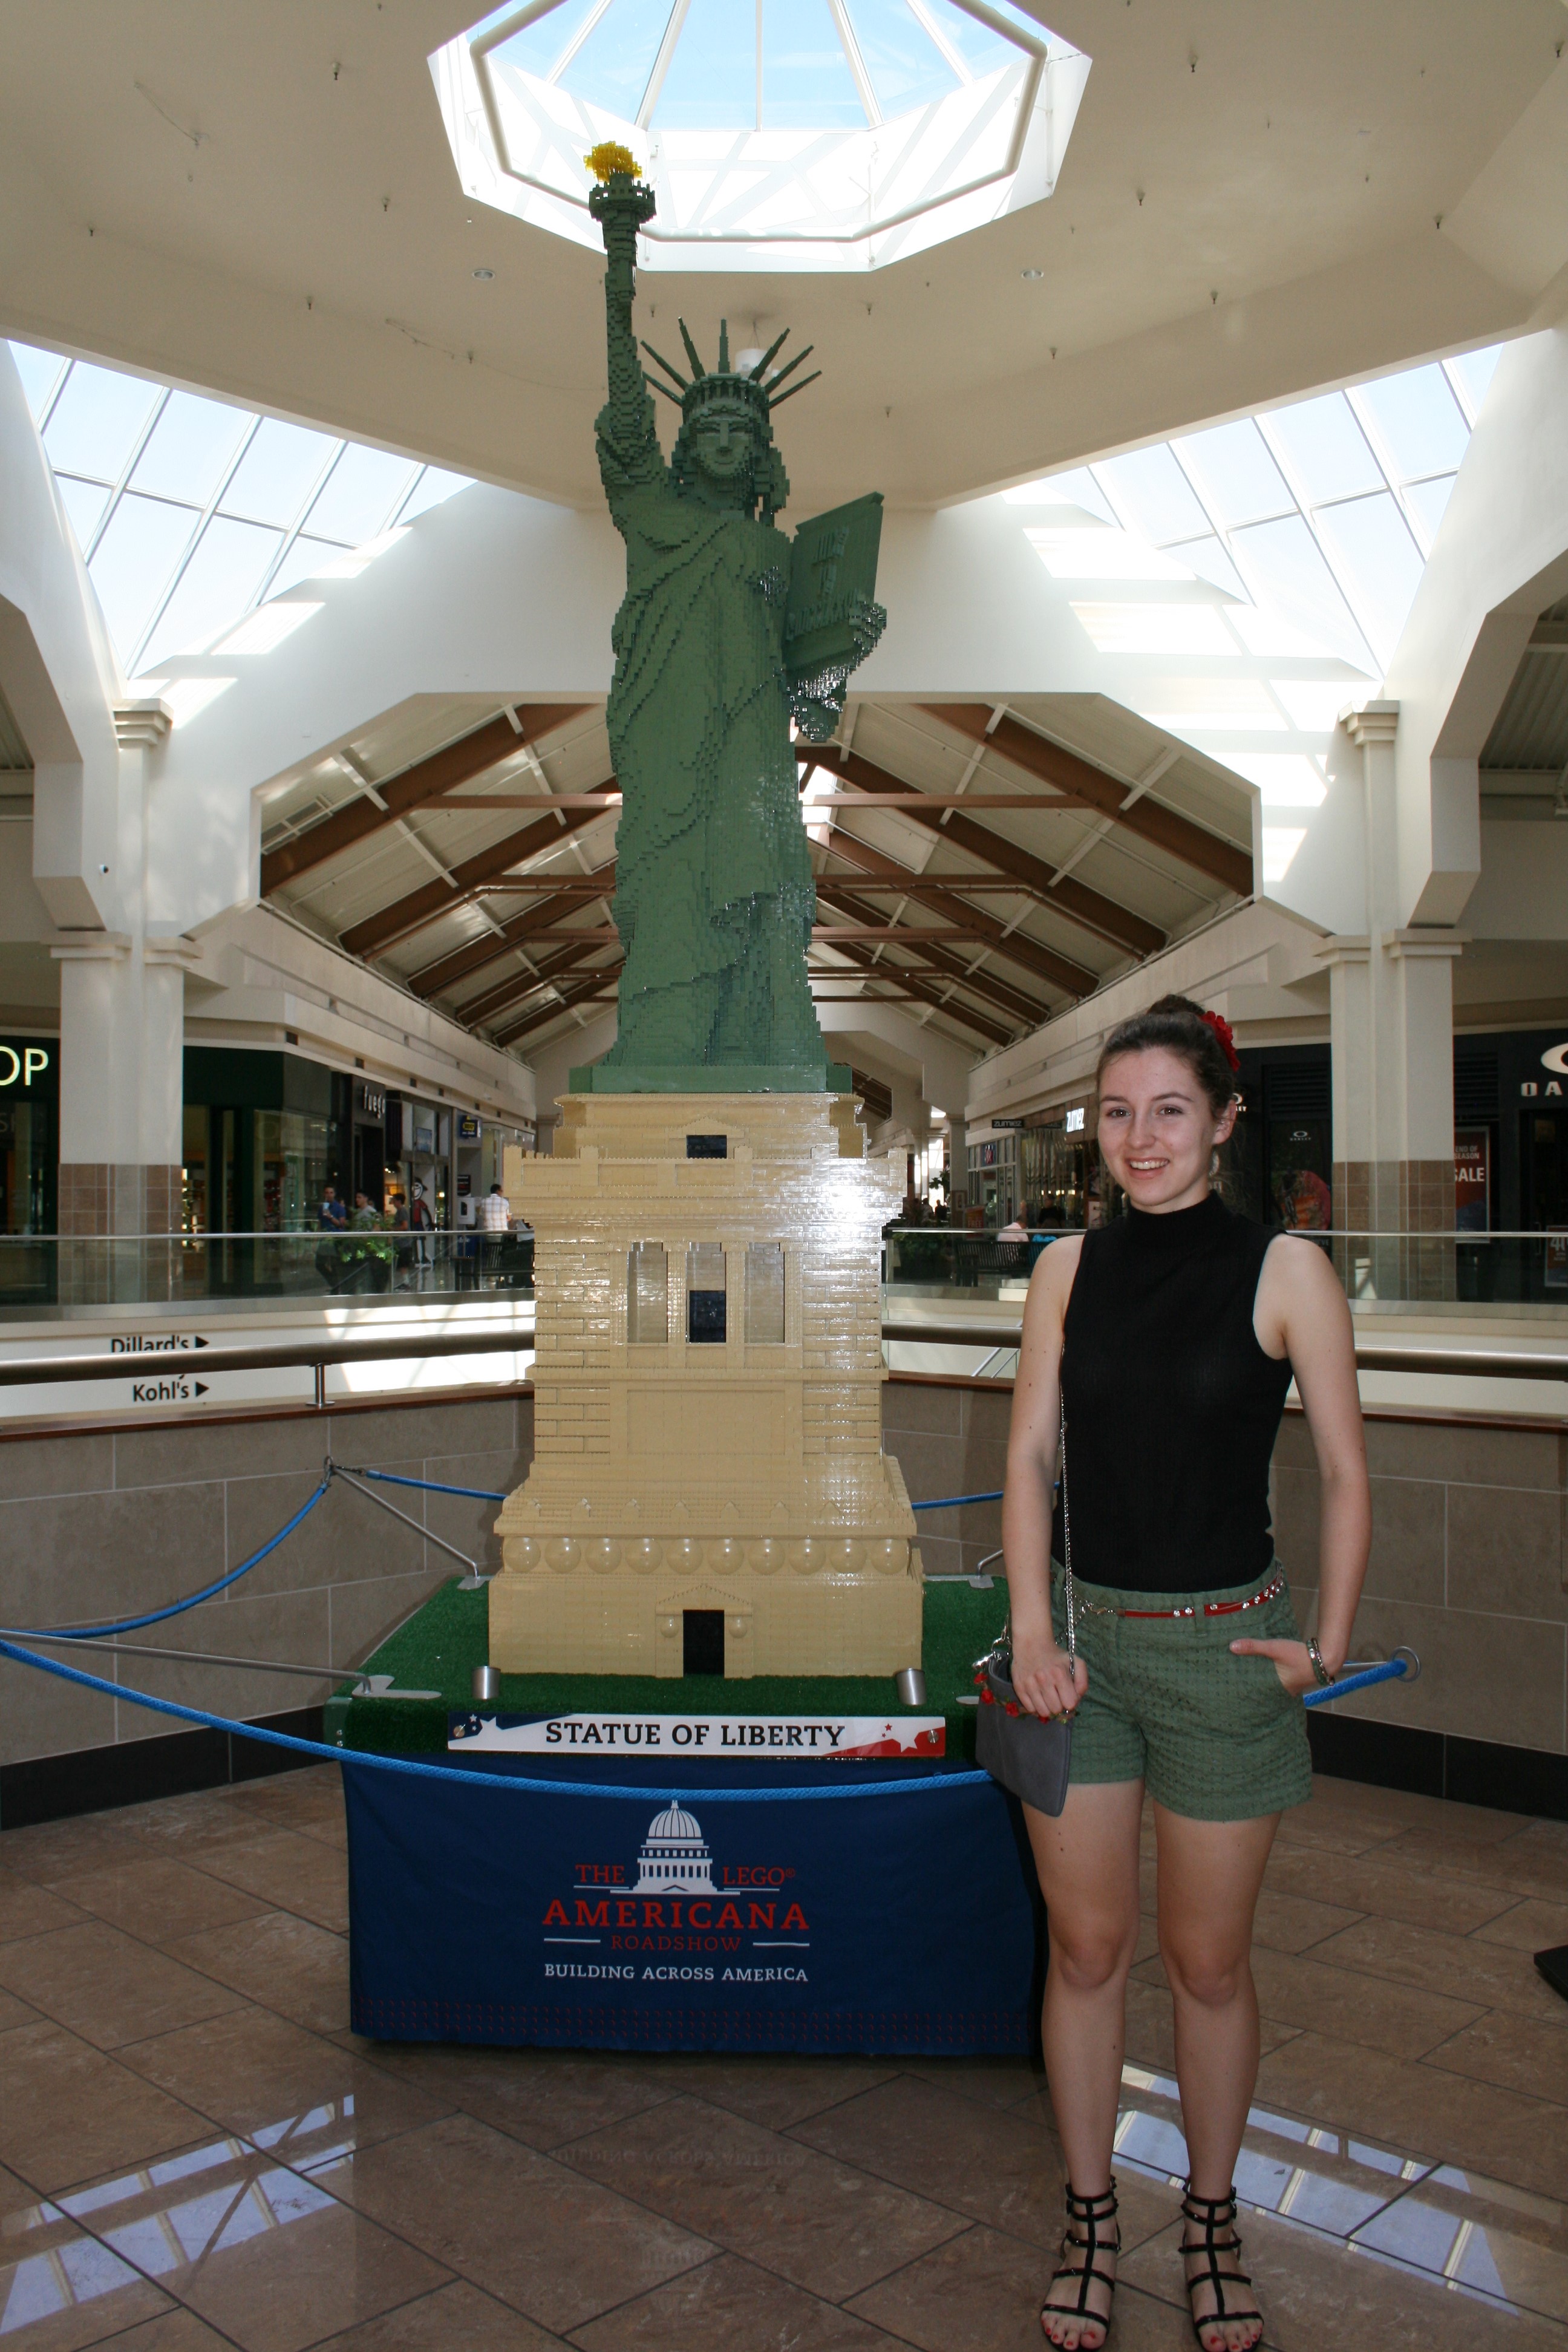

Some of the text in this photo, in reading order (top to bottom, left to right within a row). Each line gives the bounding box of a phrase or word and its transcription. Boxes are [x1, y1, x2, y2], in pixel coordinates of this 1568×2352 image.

[364, 1085, 386, 1119] fuego
[133, 1381, 189, 1402] Kohl's
[546, 1722, 845, 1746] STATUE OF LIBERTY
[575, 1864, 625, 1883] THE
[542, 1899, 810, 1930] AMERICANA
[611, 1935, 742, 1952] ROADSHOW
[544, 1964, 809, 1982] BUILDING ACROSS AMERICA
